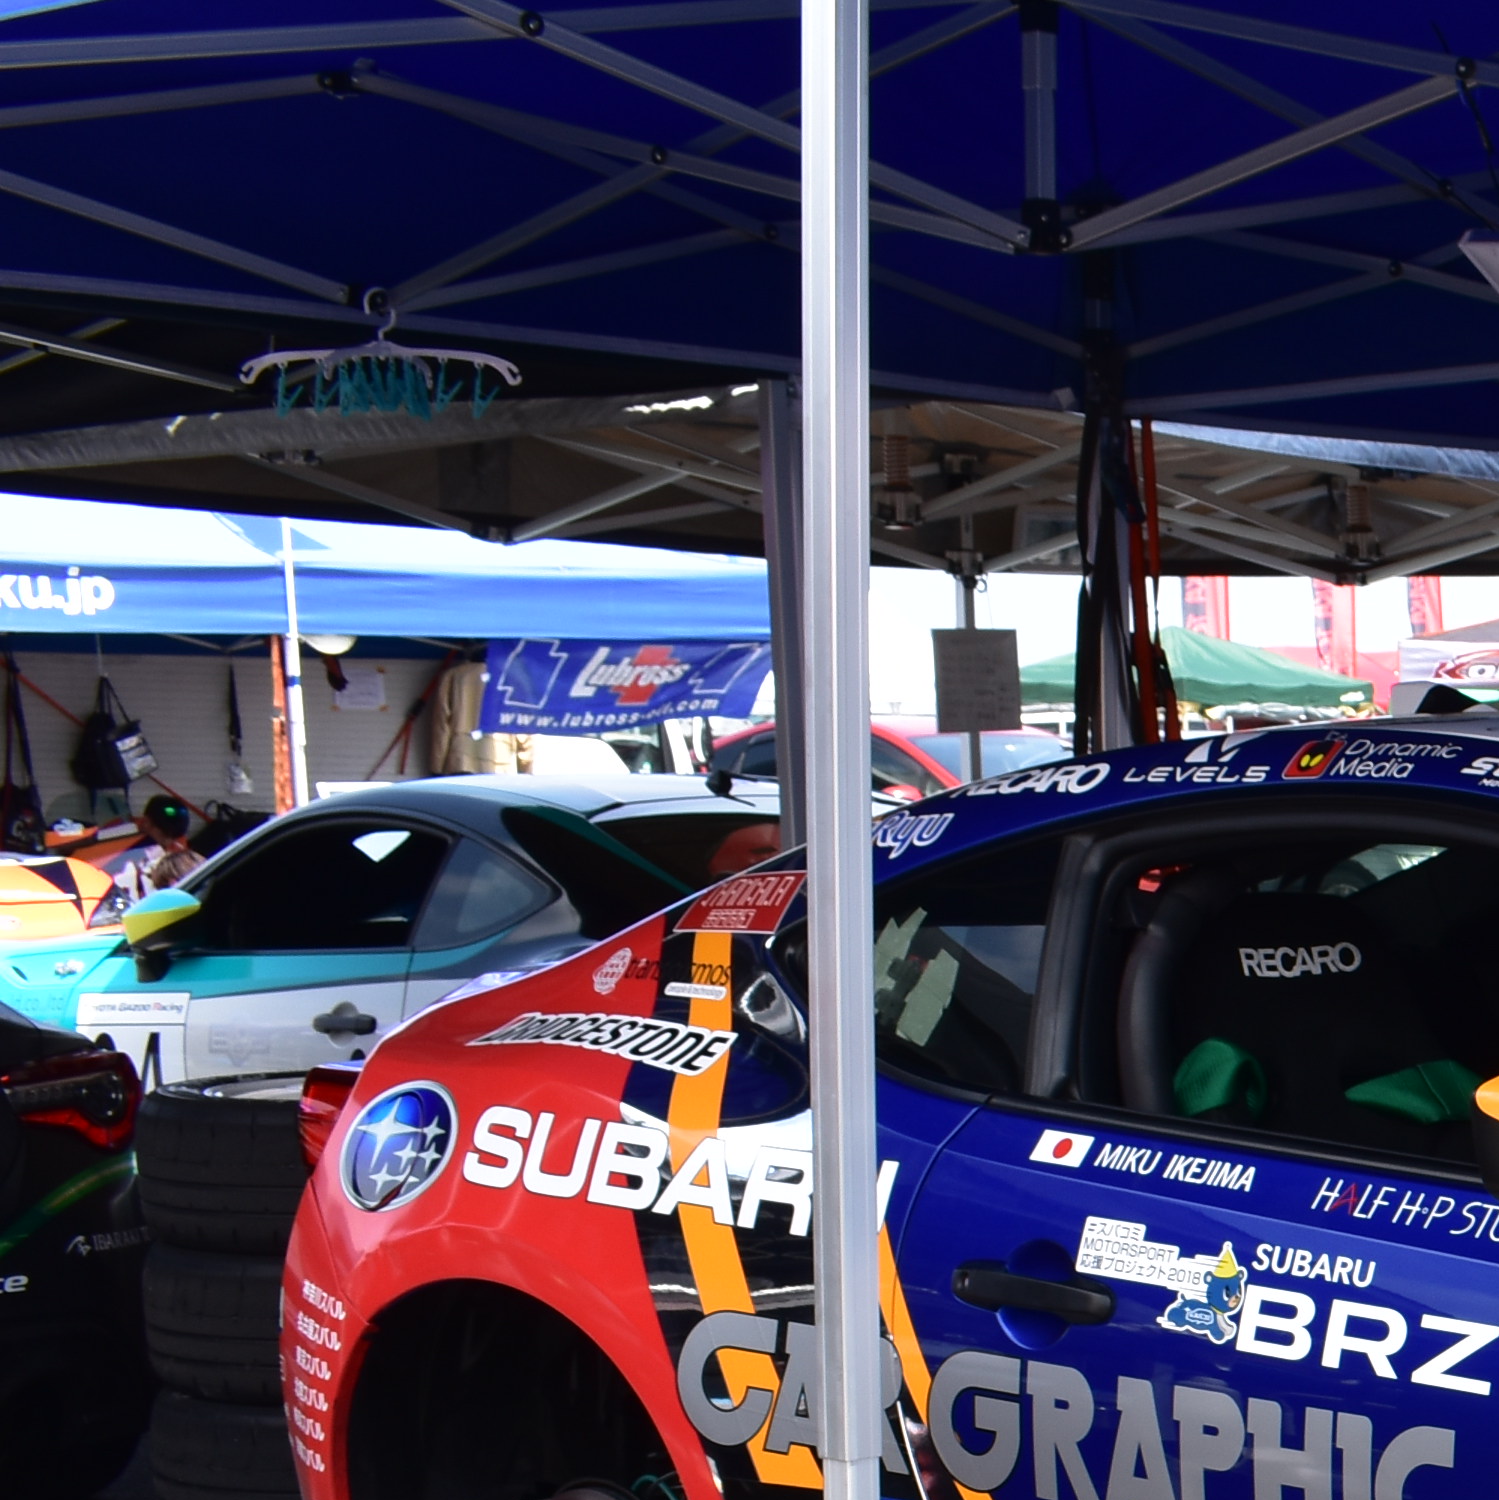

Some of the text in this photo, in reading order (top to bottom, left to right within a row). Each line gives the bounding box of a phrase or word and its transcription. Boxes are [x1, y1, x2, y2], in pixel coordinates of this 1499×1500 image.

[569, 646, 690, 697] Lubross
[1330, 757, 1414, 780] Media
[1346, 738, 1463, 760] Dynamic
[872, 810, 954, 860] Ryu
[1239, 942, 1361, 979] RECARO
[480, 1013, 733, 1074] BRIDGESTONE
[1094, 1143, 1257, 1193] MIKU IKEJIMA
[1311, 1177, 1397, 1220] HALF
[1082, 1236, 1176, 1263] MOTORSPORT
[1251, 1243, 1377, 1288] SUBARU
